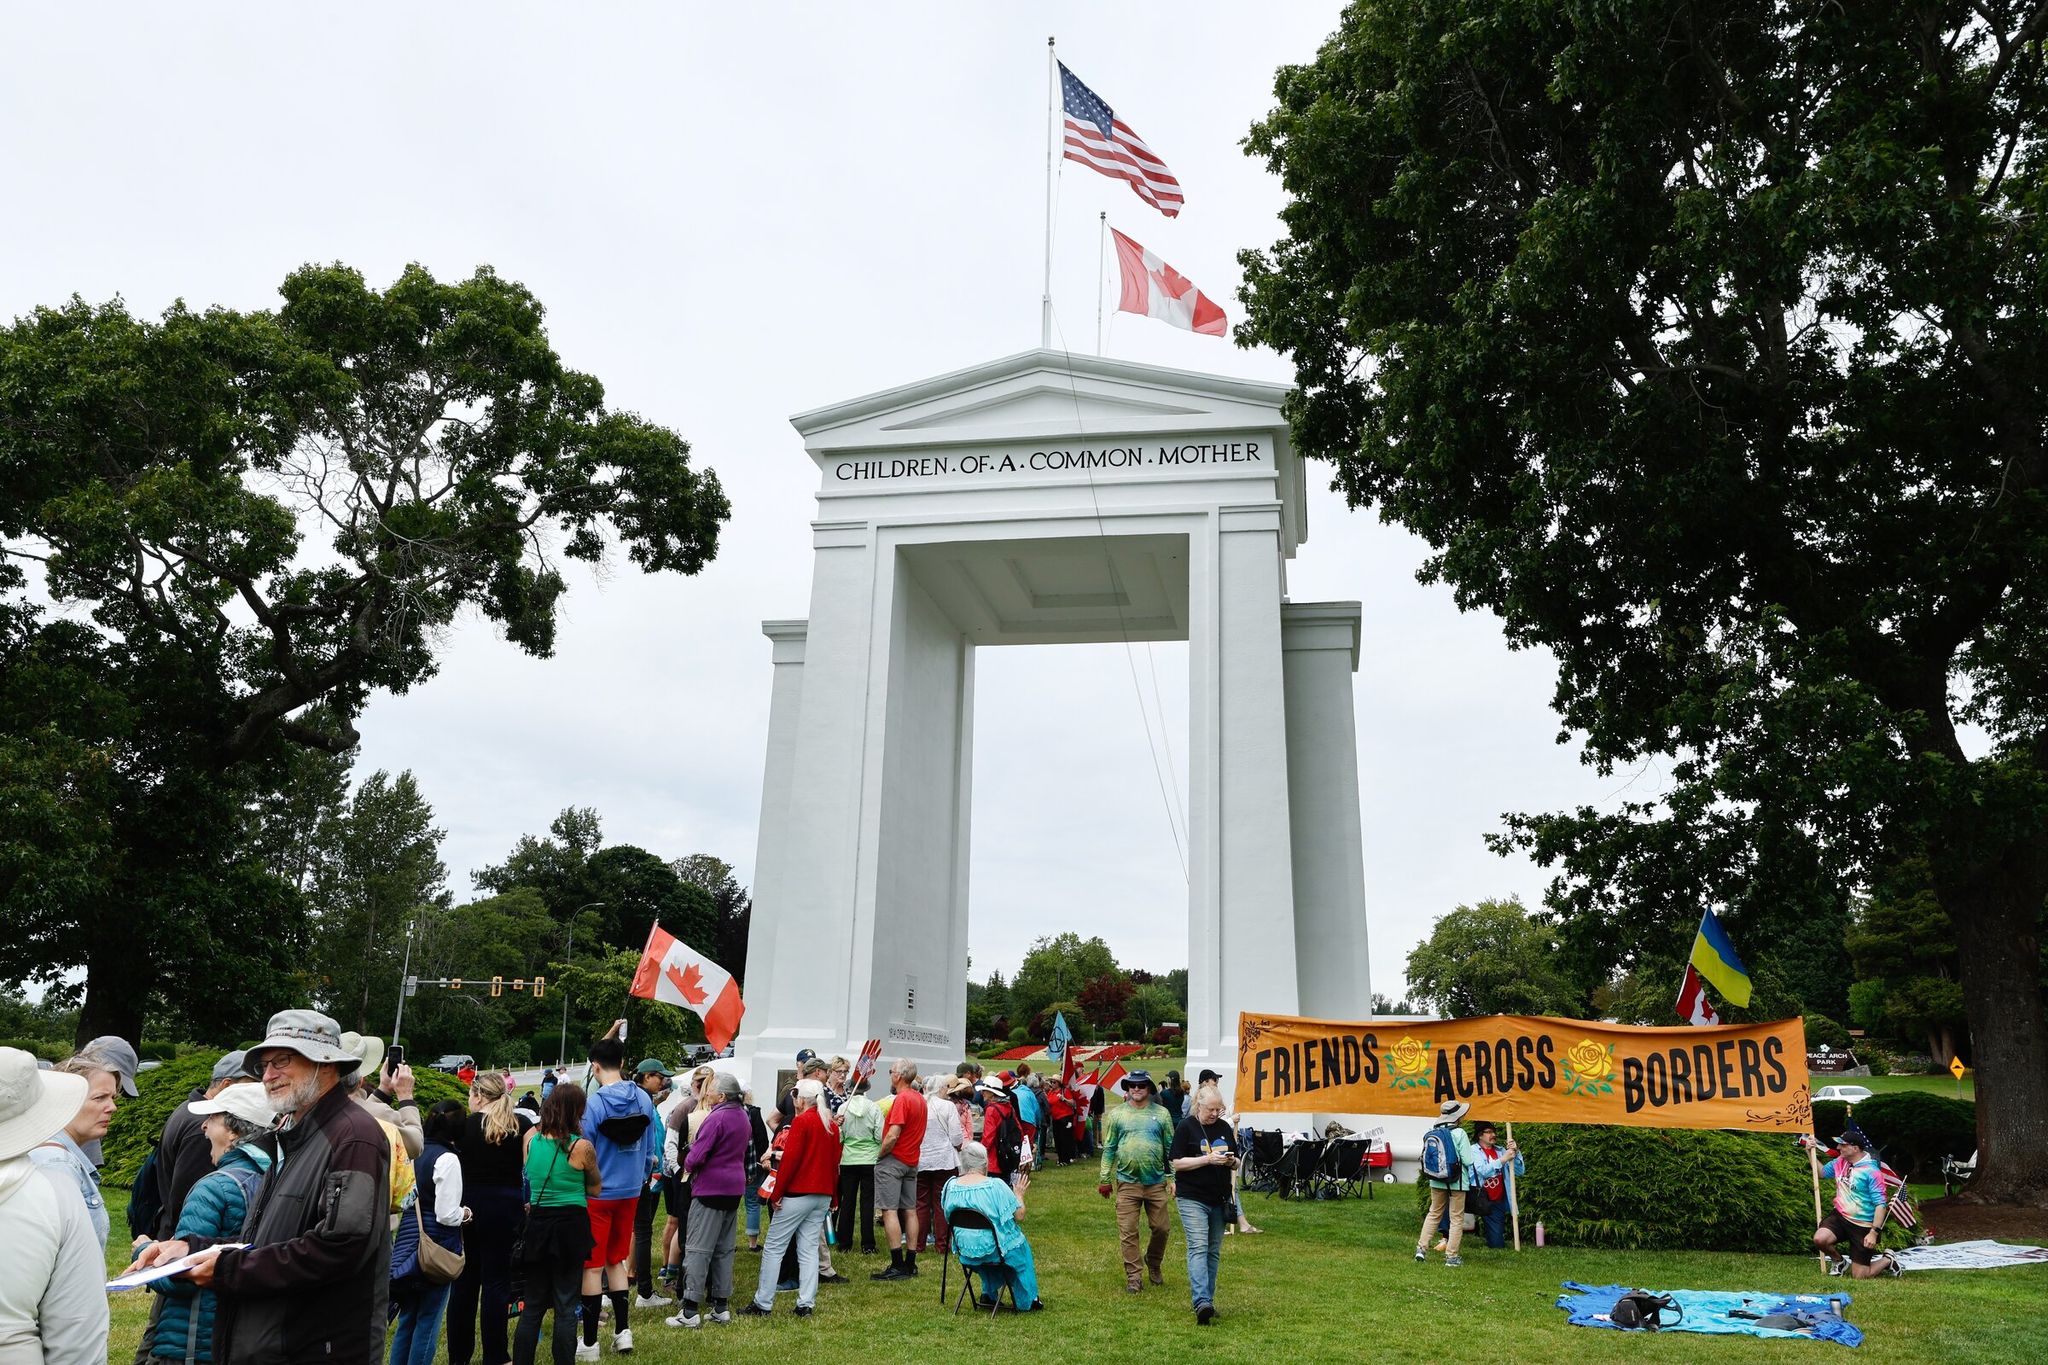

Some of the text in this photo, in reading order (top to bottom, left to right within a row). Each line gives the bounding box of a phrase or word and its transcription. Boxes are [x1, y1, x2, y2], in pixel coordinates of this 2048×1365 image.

[836, 442, 1261, 481] CHILDREN OF A COMMON MOTHER
[1254, 1033, 1788, 1114] FRIENDS ACROSS BORDERS
